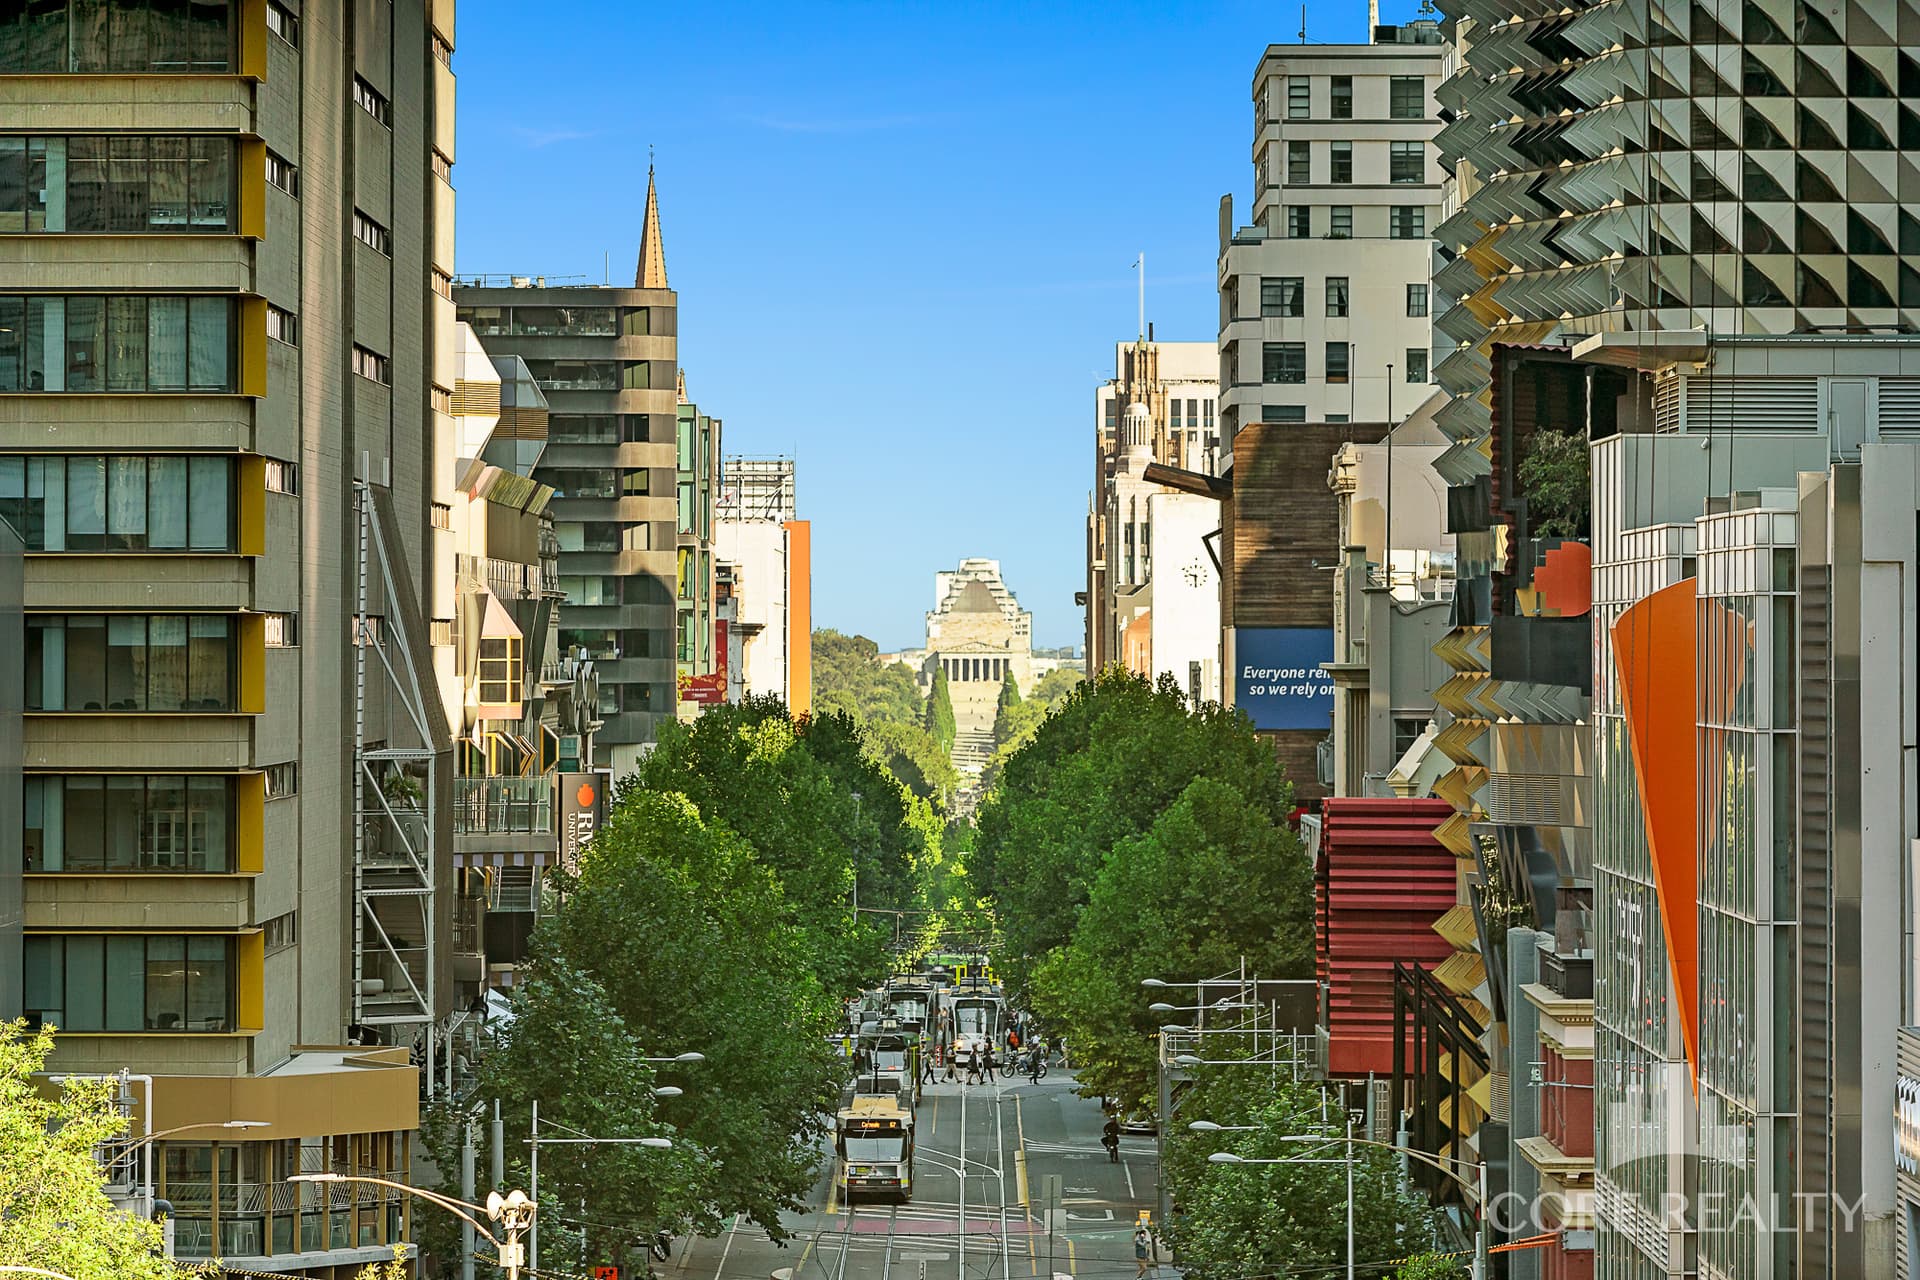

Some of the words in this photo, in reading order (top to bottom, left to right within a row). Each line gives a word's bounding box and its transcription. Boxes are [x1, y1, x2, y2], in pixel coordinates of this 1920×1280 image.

[1243, 665, 1306, 682] Everyone
[1249, 684, 1265, 695] so
[1268, 684, 1288, 695] we
[1289, 681, 1317, 699] rely
